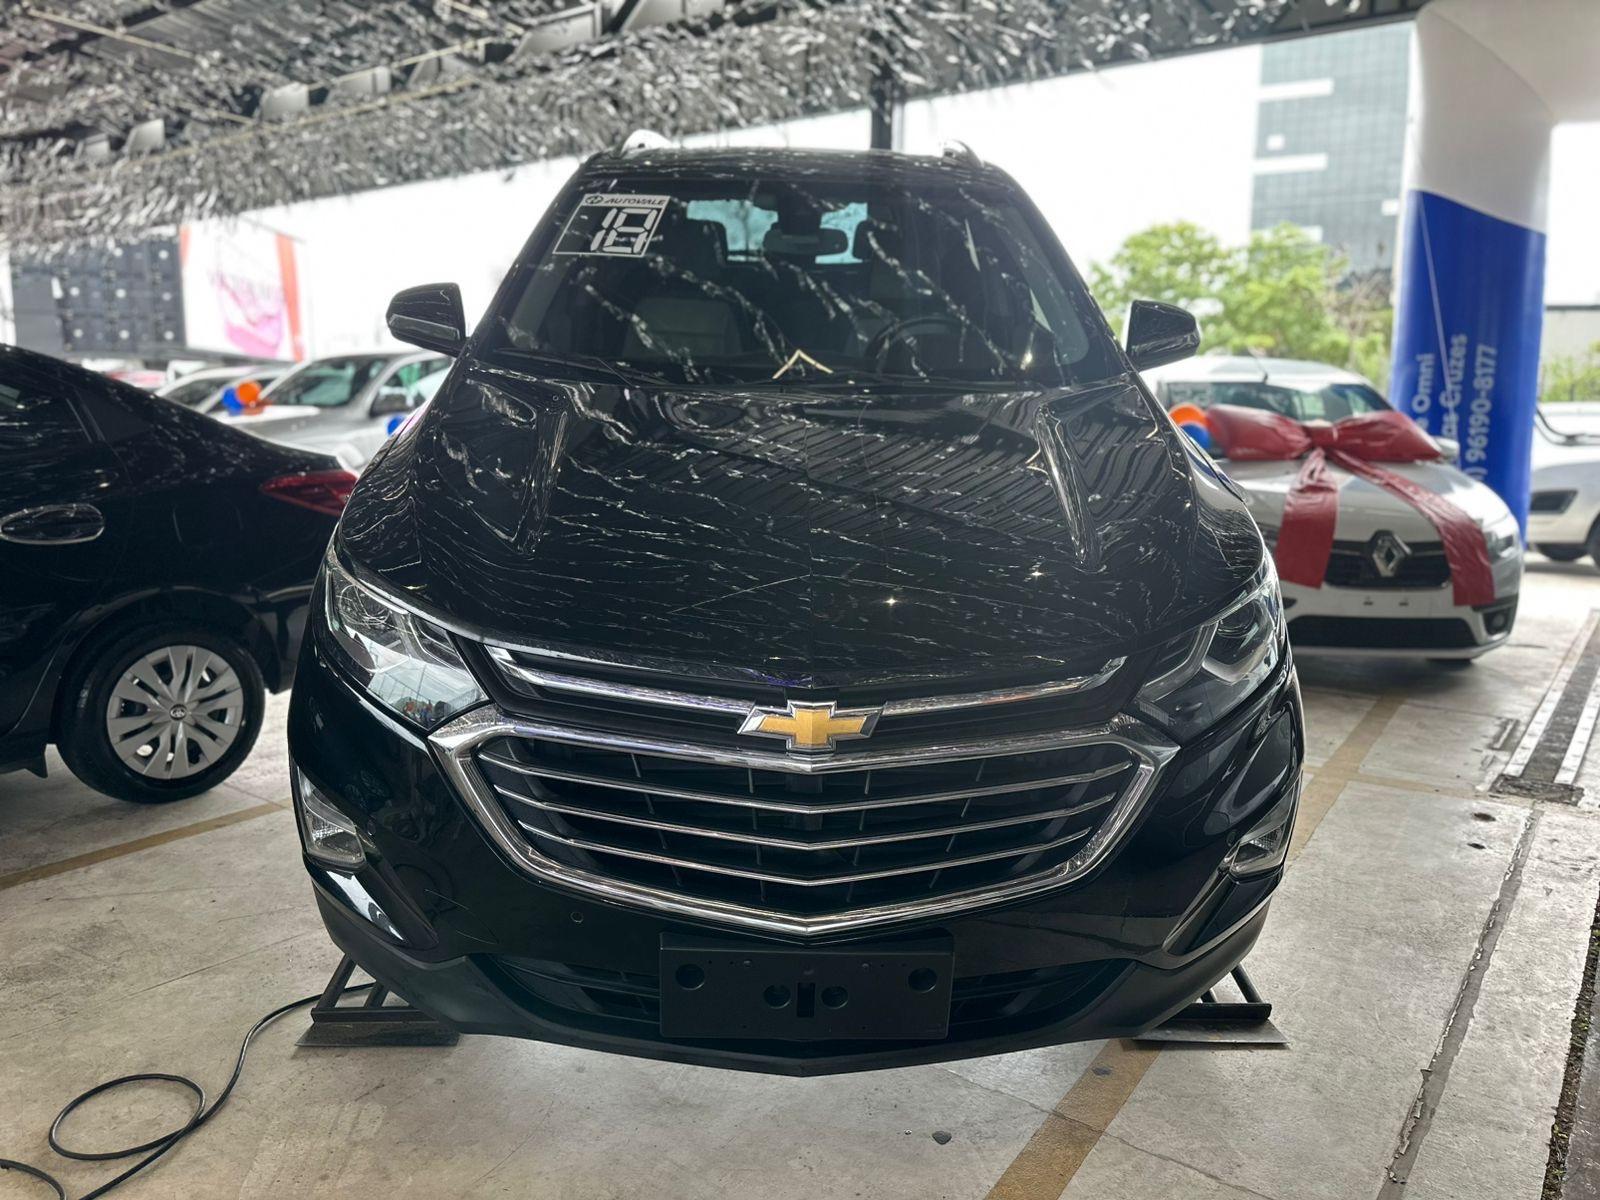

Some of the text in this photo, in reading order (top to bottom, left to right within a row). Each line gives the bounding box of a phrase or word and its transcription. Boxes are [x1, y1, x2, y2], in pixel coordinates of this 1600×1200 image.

[590, 208, 658, 254] 18
[604, 198, 667, 206] AUTOVALE
[1411, 353, 1435, 415] Omni
[1439, 333, 1469, 409] Cruzes
[1465, 345, 1498, 463] 96190-8177
